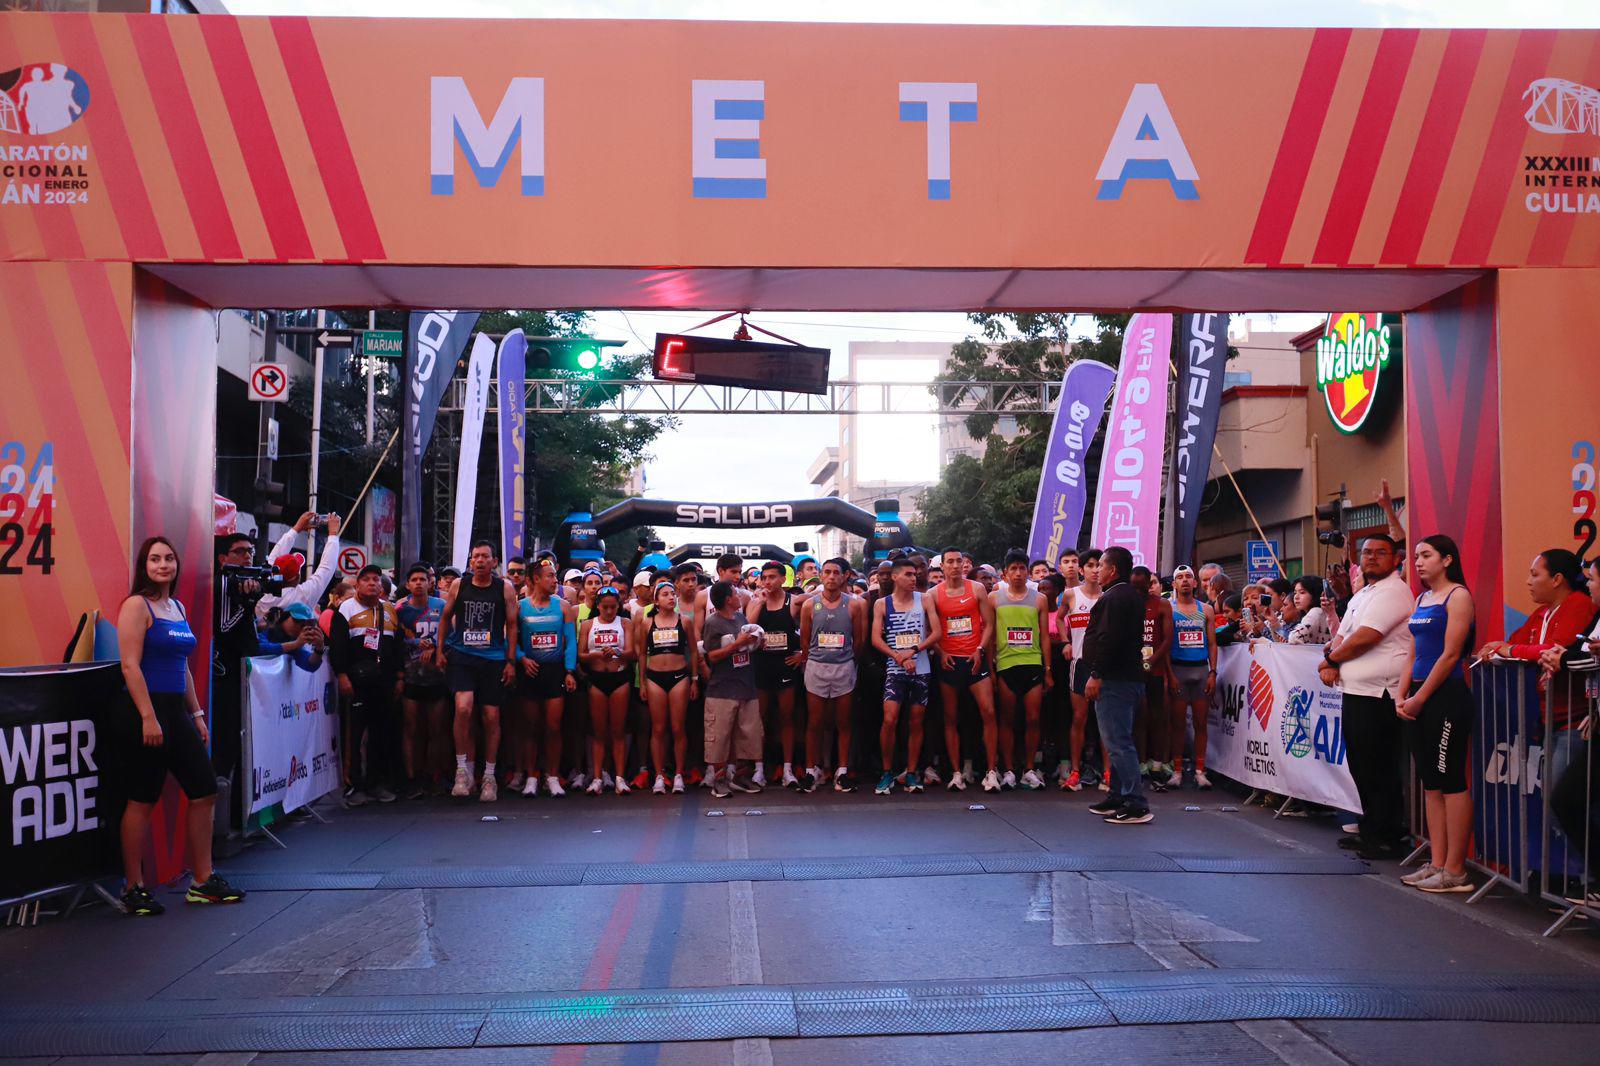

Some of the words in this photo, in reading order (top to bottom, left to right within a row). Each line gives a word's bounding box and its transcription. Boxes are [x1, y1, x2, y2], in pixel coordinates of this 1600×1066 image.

[431, 76, 1200, 201] META
[1525, 156, 1589, 171] XXXIII
[3, 165, 88, 177] CIONAL
[44, 180, 89, 189] ENERO
[1525, 175, 1600, 187] INTERN
[44, 191, 89, 204] 2024
[1525, 192, 1600, 213] CULIA
[1317, 316, 1390, 384] Waldo's
[676, 503, 793, 525] SALIDA
[700, 544, 761, 557] SALIDA
[464, 600, 496, 613] TRACK
[466, 633, 487, 641] 3660
[600, 634, 613, 642] 159
[1013, 632, 1027, 640] 106
[1184, 633, 1199, 641] 225
[0, 718, 98, 785] WER
[1436, 719, 1453, 774] dportenis
[12, 778, 99, 847] ADE
